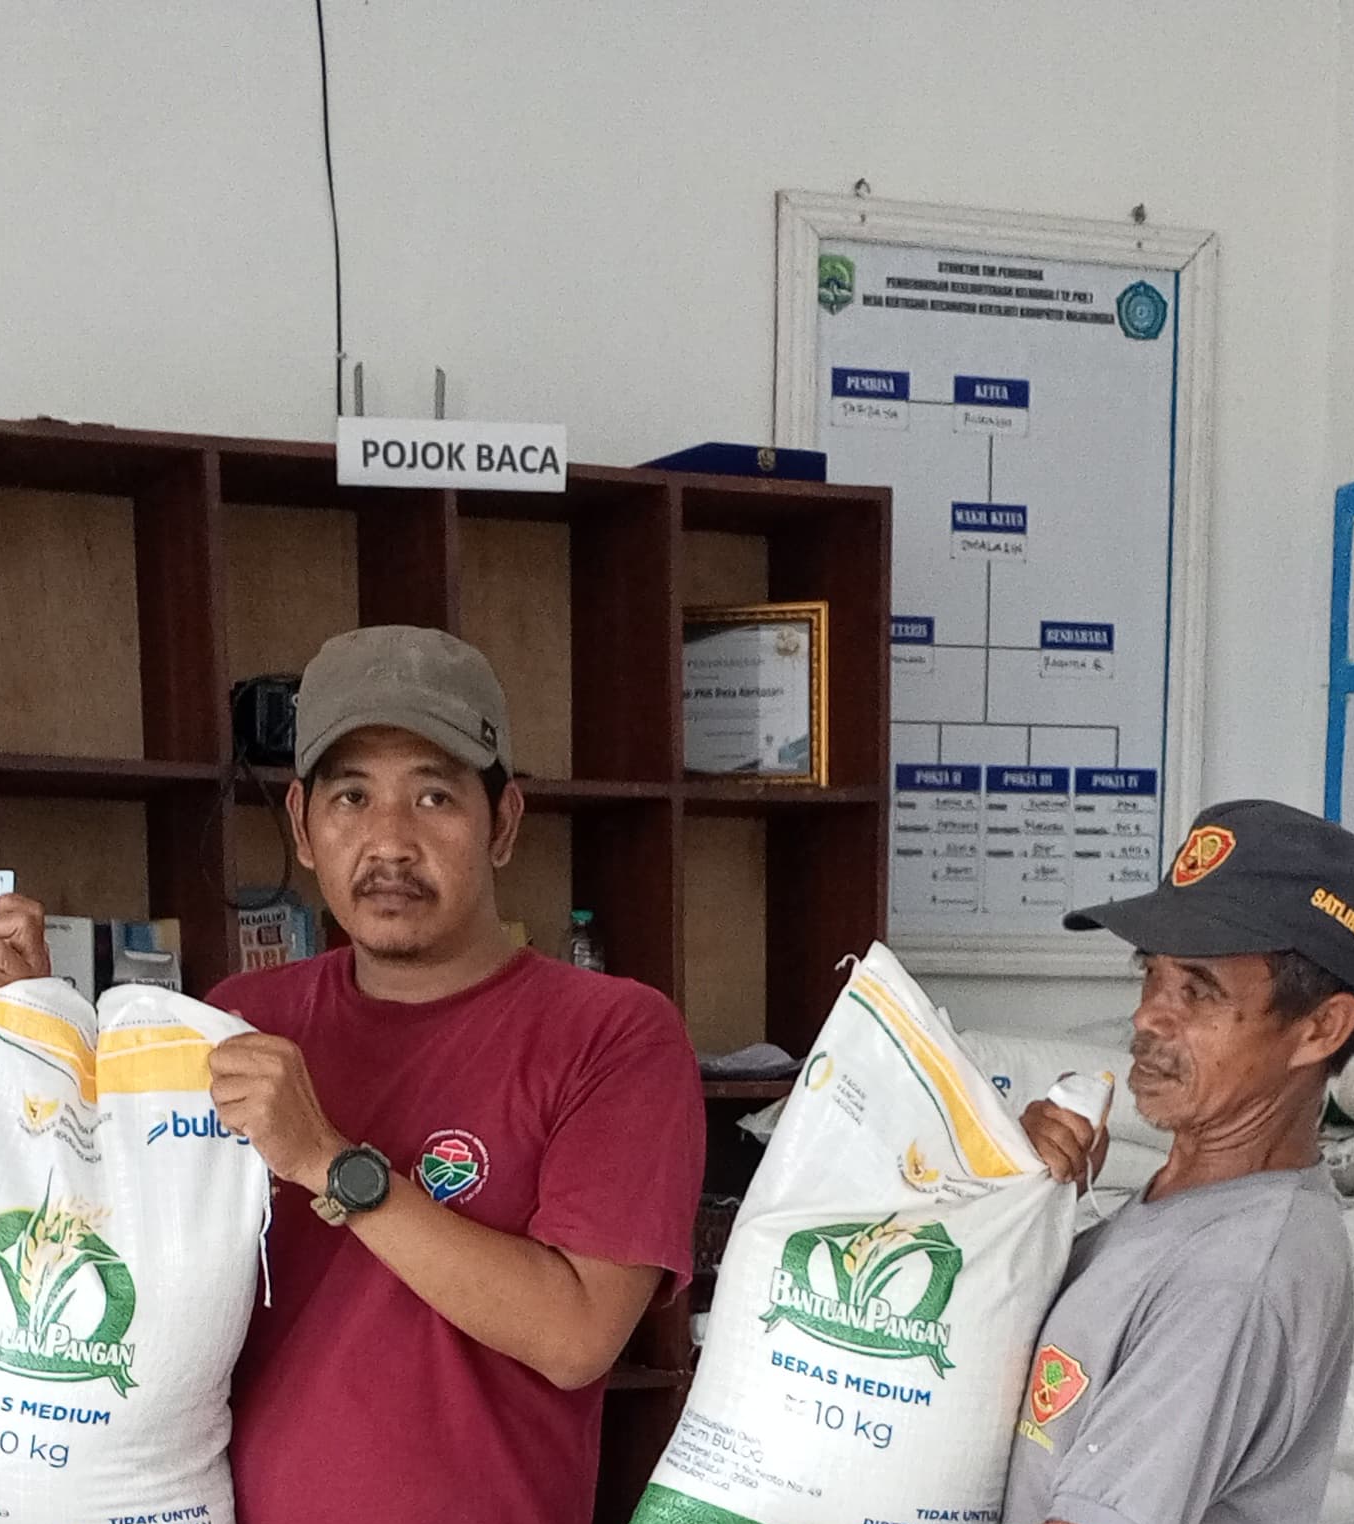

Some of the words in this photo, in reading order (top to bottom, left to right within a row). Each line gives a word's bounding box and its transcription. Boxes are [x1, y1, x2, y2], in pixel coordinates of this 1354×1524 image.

[362, 440, 466, 471] POJOK
[476, 443, 560, 475] BACA
[769, 1266, 863, 1329] BANTUAN
[864, 1295, 952, 1348] PANGAN
[44, 1322, 136, 1368] PANGAN
[771, 1350, 839, 1386] BERAS
[844, 1374, 933, 1407] MEDIUM
[20, 1400, 112, 1426] MEDIUM
[814, 1400, 845, 1431] 10
[853, 1410, 893, 1449] kg
[29, 1434, 70, 1468] kg
[711, 1432, 765, 1464] BULOG
[162, 1504, 210, 1523] UNTUK
[916, 1509, 959, 1522] TIDAK
